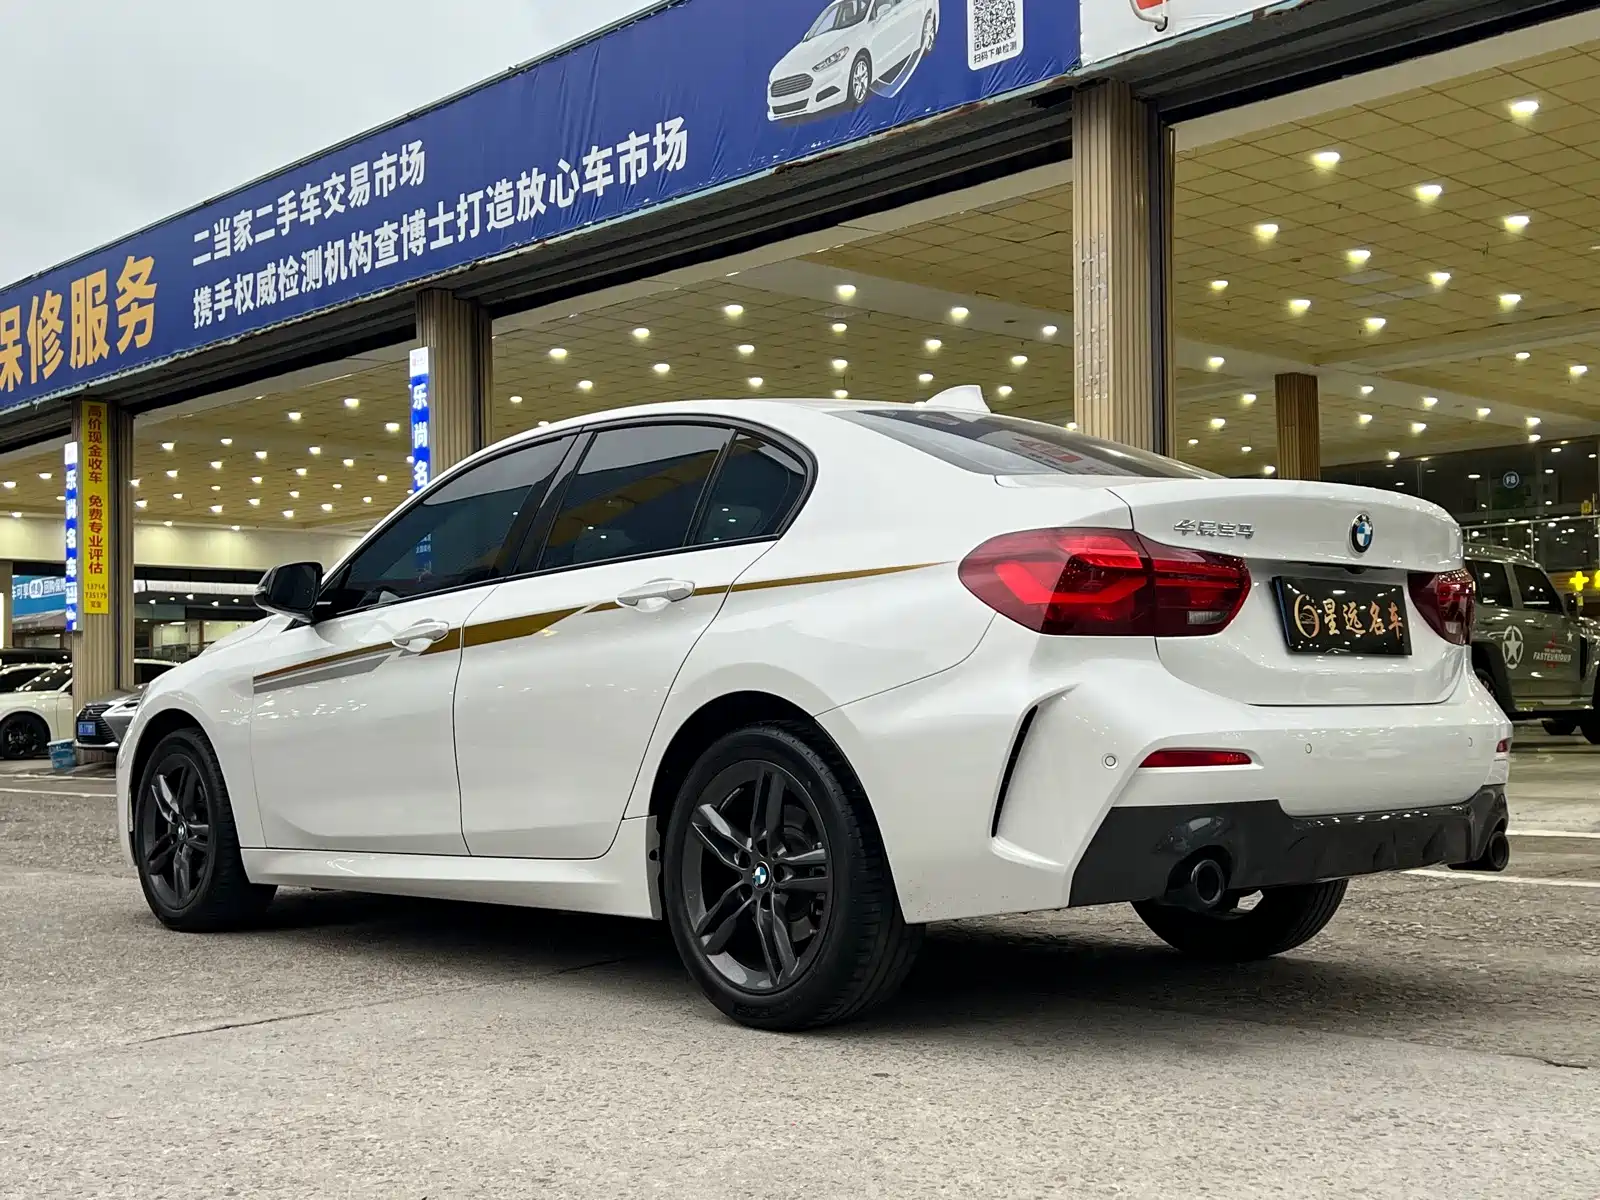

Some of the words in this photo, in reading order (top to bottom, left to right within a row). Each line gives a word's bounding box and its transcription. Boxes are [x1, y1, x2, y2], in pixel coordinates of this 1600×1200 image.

[192, 139, 426, 266] 二当家二手车交易市场
[192, 116, 688, 329] 携手权威检测机构查博士打造放心车市场
[0, 255, 158, 393] 保修服务
[87, 405, 103, 484] 高价现金收车
[88, 494, 104, 575] 免费专业评估
